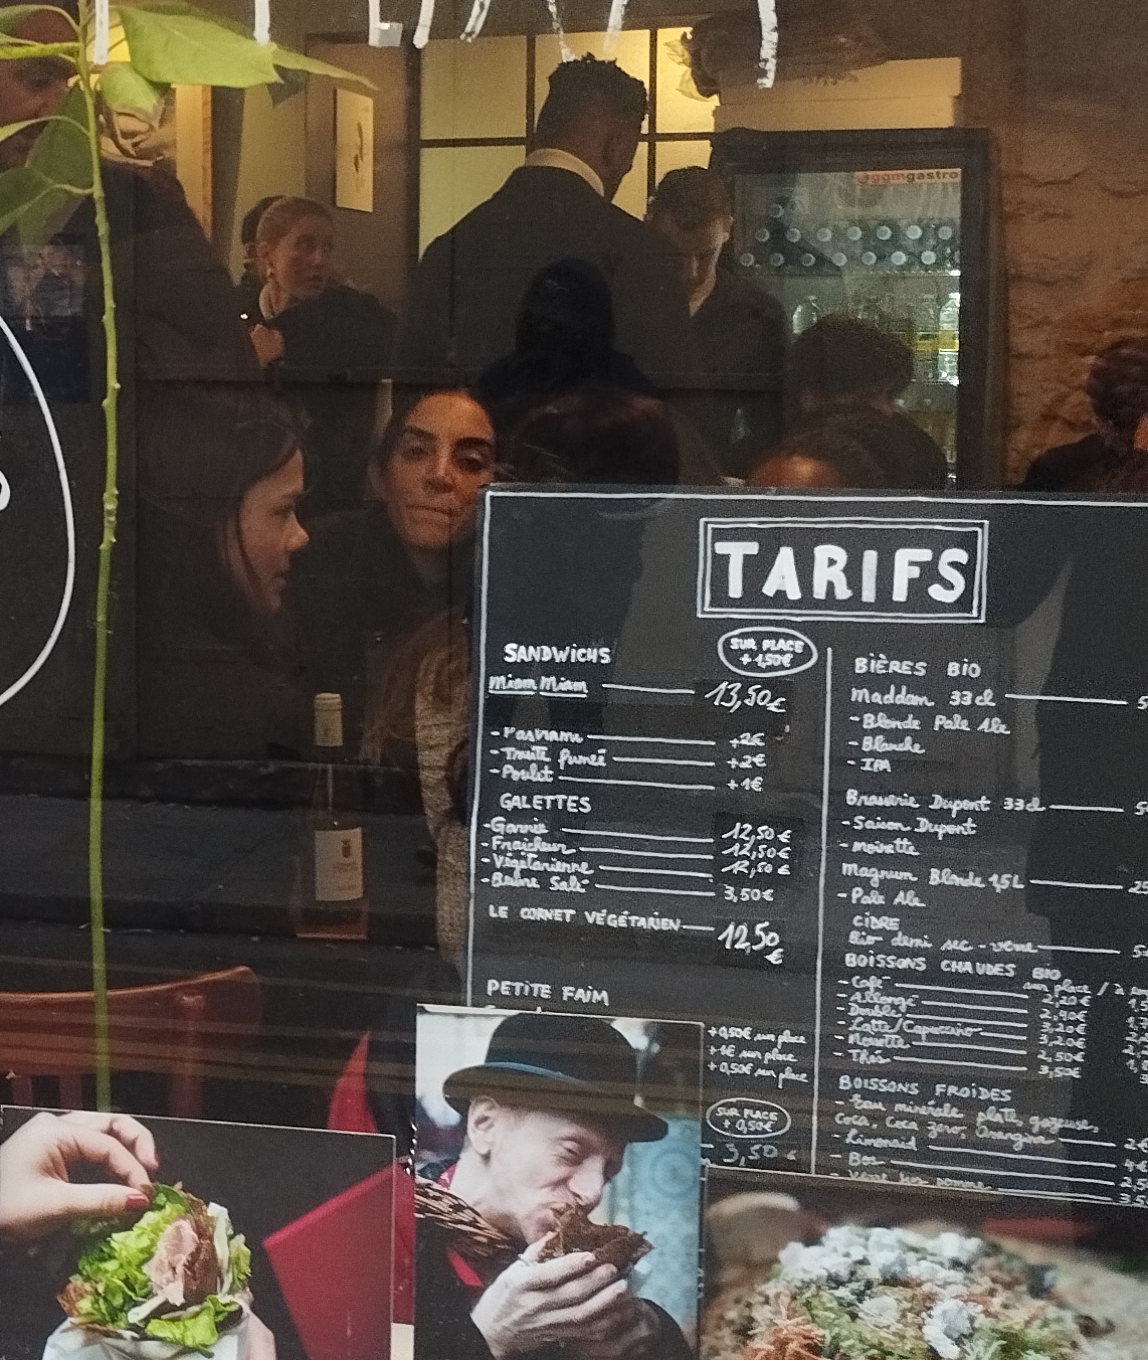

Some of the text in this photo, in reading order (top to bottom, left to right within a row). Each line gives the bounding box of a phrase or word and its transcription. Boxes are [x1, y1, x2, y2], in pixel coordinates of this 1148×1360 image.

[713, 540, 971, 603] TARIFS
[729, 637, 805, 654] SUR PLACE
[499, 791, 592, 814] GALETTES
[488, 904, 508, 919] LE
[838, 1074, 920, 1096] BOISSONS
[715, 1106, 779, 1122] SUR PLACE
